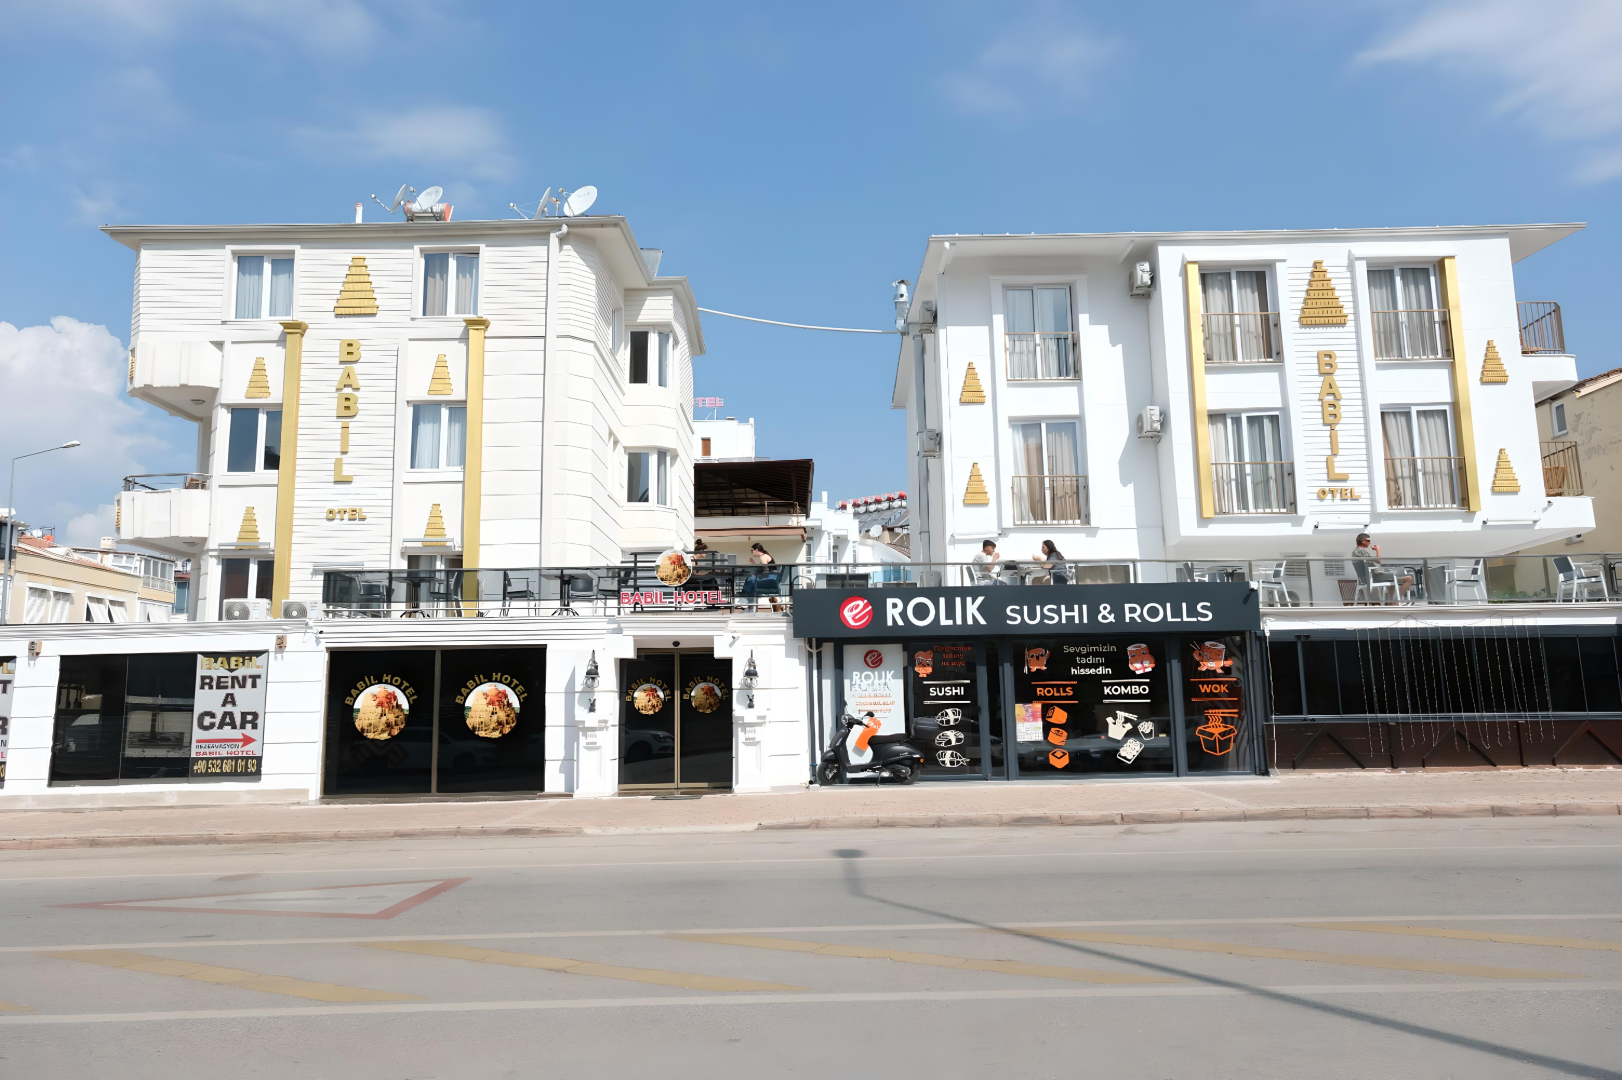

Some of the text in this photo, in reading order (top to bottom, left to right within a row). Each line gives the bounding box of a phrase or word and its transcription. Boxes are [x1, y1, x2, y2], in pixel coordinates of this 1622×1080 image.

[1317, 487, 1361, 500] OTEL
[325, 508, 367, 521] OTEL
[674, 590, 728, 604] HOTEL
[886, 596, 1213, 626] ROLIK SUSHI & ROLLS
[1063, 644, 1117, 655] Sevgimizin
[1076, 656, 1105, 664] tadını
[1071, 666, 1112, 675] hissedin
[199, 674, 261, 690] RENT
[382, 673, 418, 705] HOTEL
[492, 672, 528, 703] HOTEL
[649, 677, 673, 701] HOTEL
[706, 675, 730, 700] HOTEL
[1199, 684, 1229, 693] WOK
[929, 686, 965, 696] SUSHI
[1036, 686, 1074, 697] ROLLS
[1103, 685, 1149, 695] KOMBO
[221, 693, 237, 708] A
[197, 711, 259, 731] CAR
[193, 759, 207, 773] +90
[207, 759, 222, 773] 532
[237, 758, 246, 773] 01
[247, 758, 257, 773] 93
